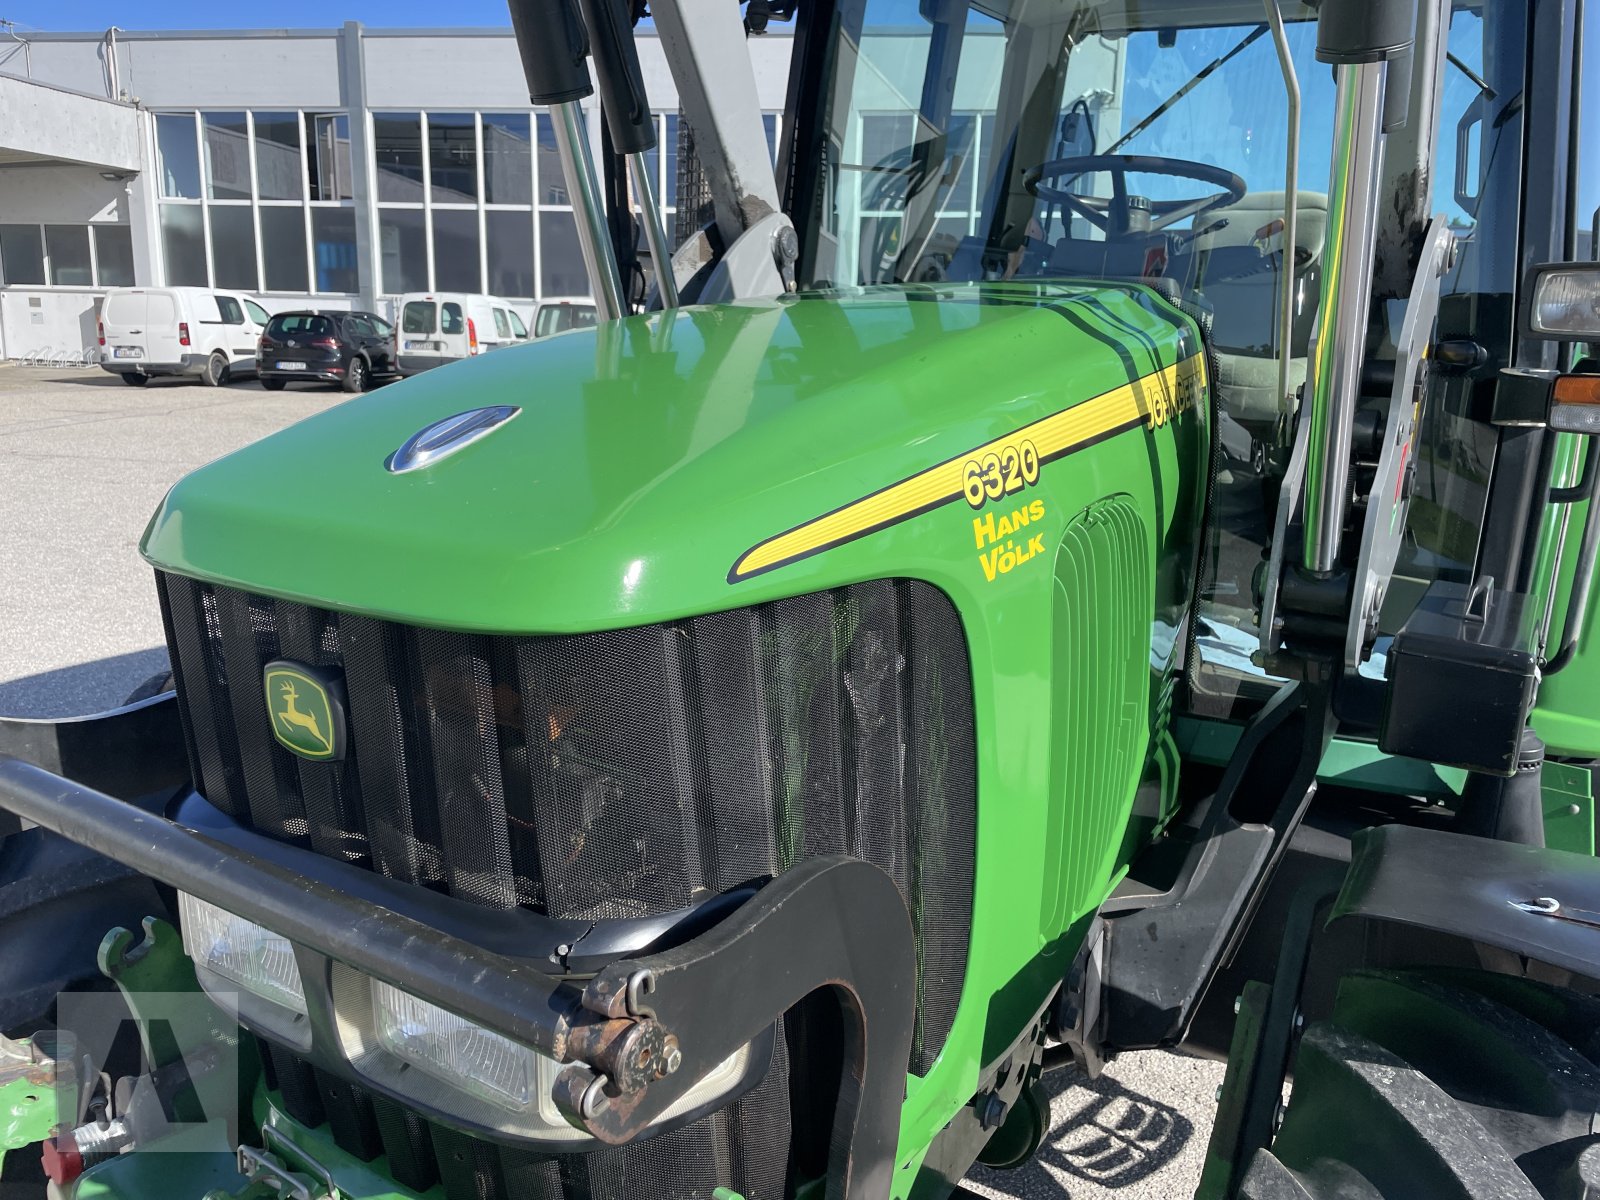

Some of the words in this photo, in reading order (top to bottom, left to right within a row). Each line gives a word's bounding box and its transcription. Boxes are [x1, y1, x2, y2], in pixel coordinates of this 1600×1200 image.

[962, 438, 1041, 510] 6320
[973, 499, 1045, 550] HANS
[979, 532, 1046, 582] VÖLK
